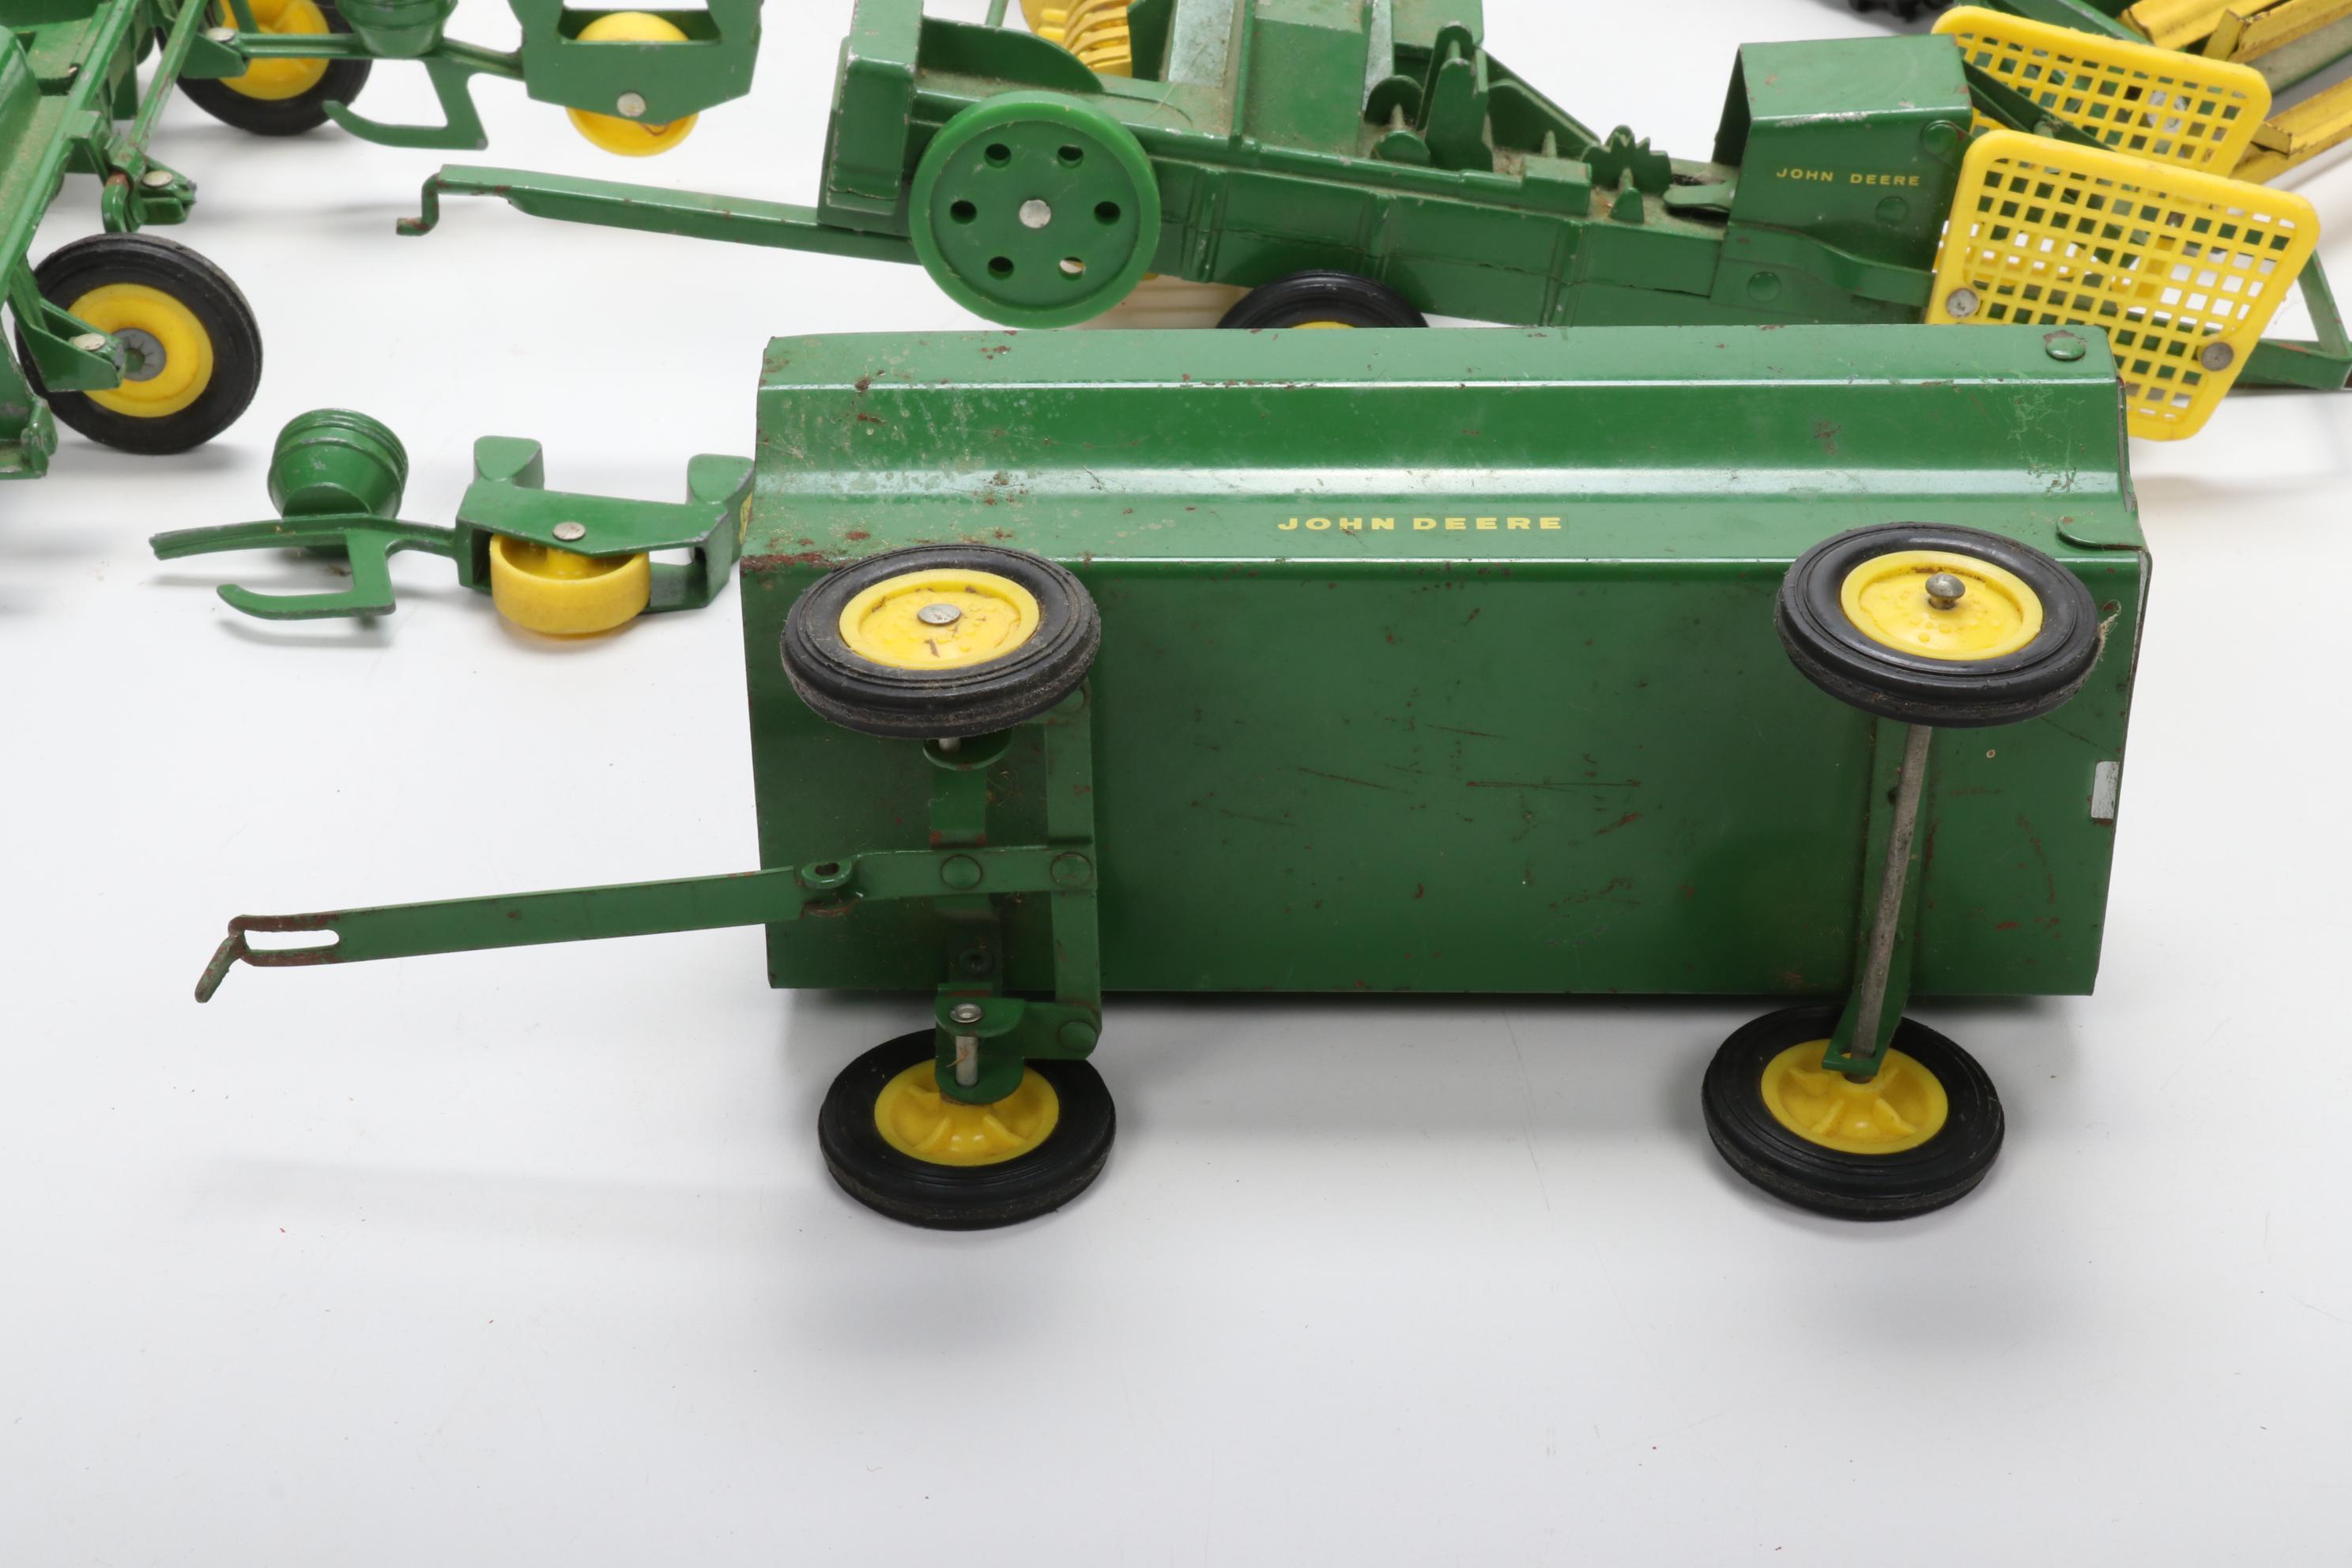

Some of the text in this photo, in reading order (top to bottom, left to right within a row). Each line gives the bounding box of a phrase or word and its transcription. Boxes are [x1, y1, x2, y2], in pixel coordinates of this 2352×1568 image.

[1775, 168, 1921, 187] JOHN DEERE
[1277, 516, 1562, 532] JOHN DEERE
